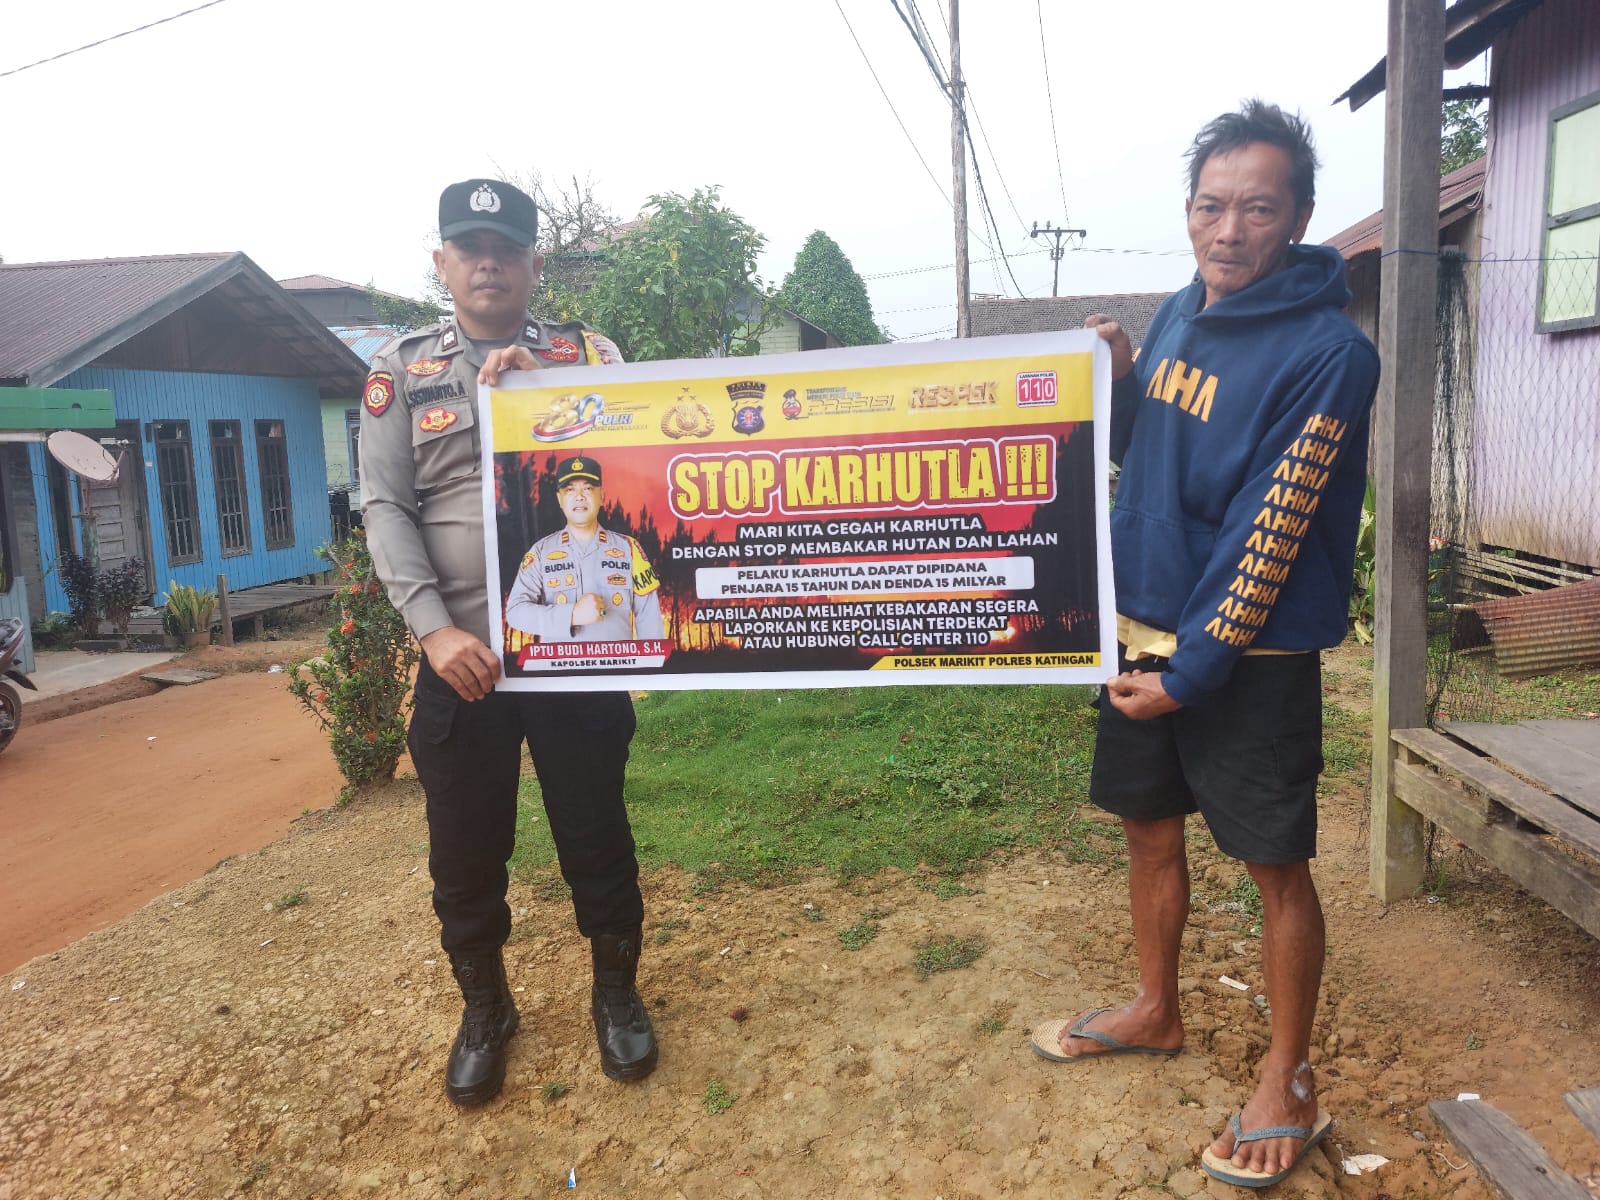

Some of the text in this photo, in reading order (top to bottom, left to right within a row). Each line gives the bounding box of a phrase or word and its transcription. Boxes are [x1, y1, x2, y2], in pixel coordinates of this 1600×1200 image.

[910, 382, 997, 408] RESPEK
[1021, 380, 1054, 399] 110
[594, 414, 633, 426] POLRI
[674, 443, 1048, 511] STOP KARHUTLA !!!
[740, 517, 983, 539] MARI KITA CEGAH KARHUTLA
[672, 533, 1058, 559] DENGAN STOP MEMBAKAR HUTAN DAN LAHAN
[601, 560, 631, 570] POLRI
[738, 562, 987, 580] PELAKU KARHUTLA DAPAT DIPIDANA
[721, 576, 1006, 595] PENJARA 15 TAHUN DAN DENDA 15 MILYAR
[694, 600, 1039, 621] APABILA ANDA MELIHAT KEBAKARAN SEGERA
[725, 616, 1007, 635] LAPORKAN KE KEPOLISIAN TERDEKAT
[529, 641, 665, 657] IPTU BUDI HARTONO, S.H.
[744, 632, 988, 649] ATAU HUBUNGI CALL CENTER 110
[551, 658, 637, 667] KAPOLSEK MARIKIT
[894, 655, 1093, 667] POLSEK MARIKIT POLRES KATINGAN
